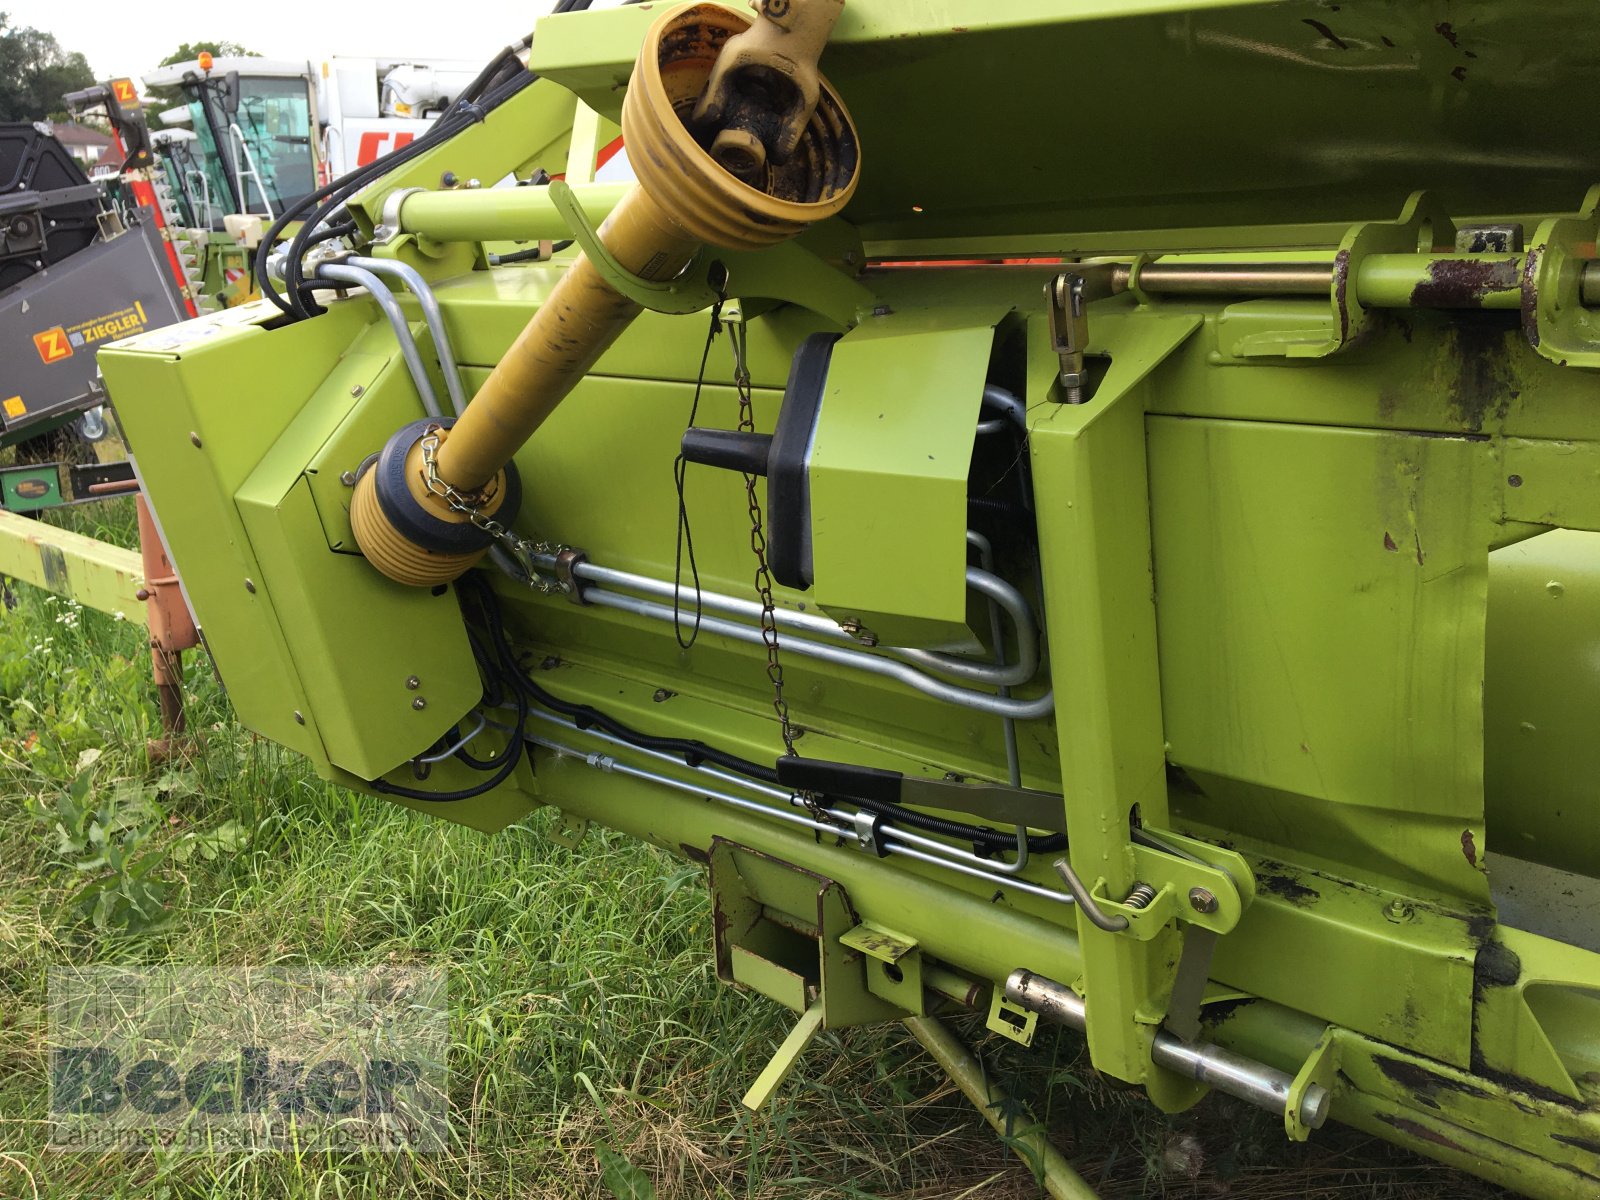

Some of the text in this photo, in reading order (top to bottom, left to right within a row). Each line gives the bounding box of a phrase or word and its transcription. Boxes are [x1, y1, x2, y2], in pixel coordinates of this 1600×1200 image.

[116, 82, 133, 100] Z
[82, 314, 141, 343] ZIEGLER
[42, 332, 66, 359] Z
